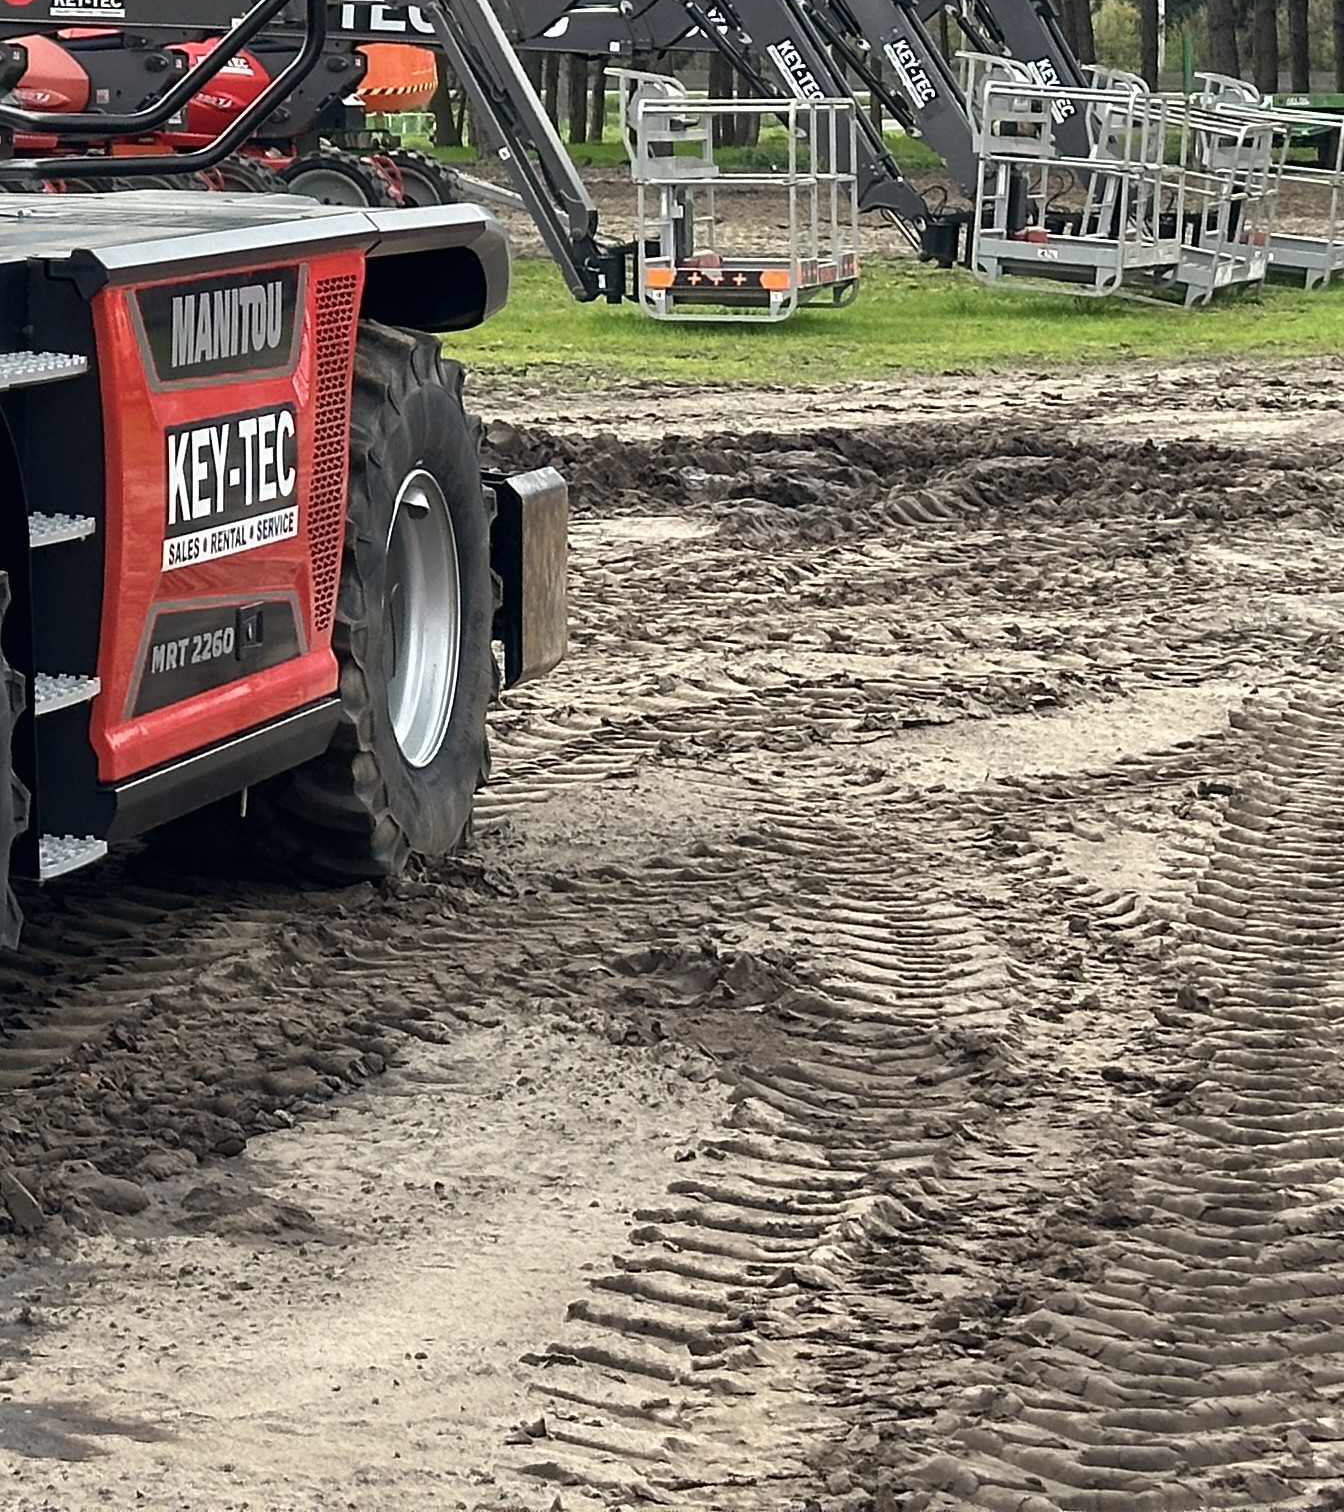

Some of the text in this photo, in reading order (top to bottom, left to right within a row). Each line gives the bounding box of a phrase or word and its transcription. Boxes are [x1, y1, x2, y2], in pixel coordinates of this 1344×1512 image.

[892, 39, 936, 102] KEY-TEC
[171, 281, 283, 368] MANITOU
[167, 409, 296, 526] KEY-TEC
[168, 512, 295, 566] SALES RENTAL SERVICE
[151, 626, 235, 674] MRT 2260
